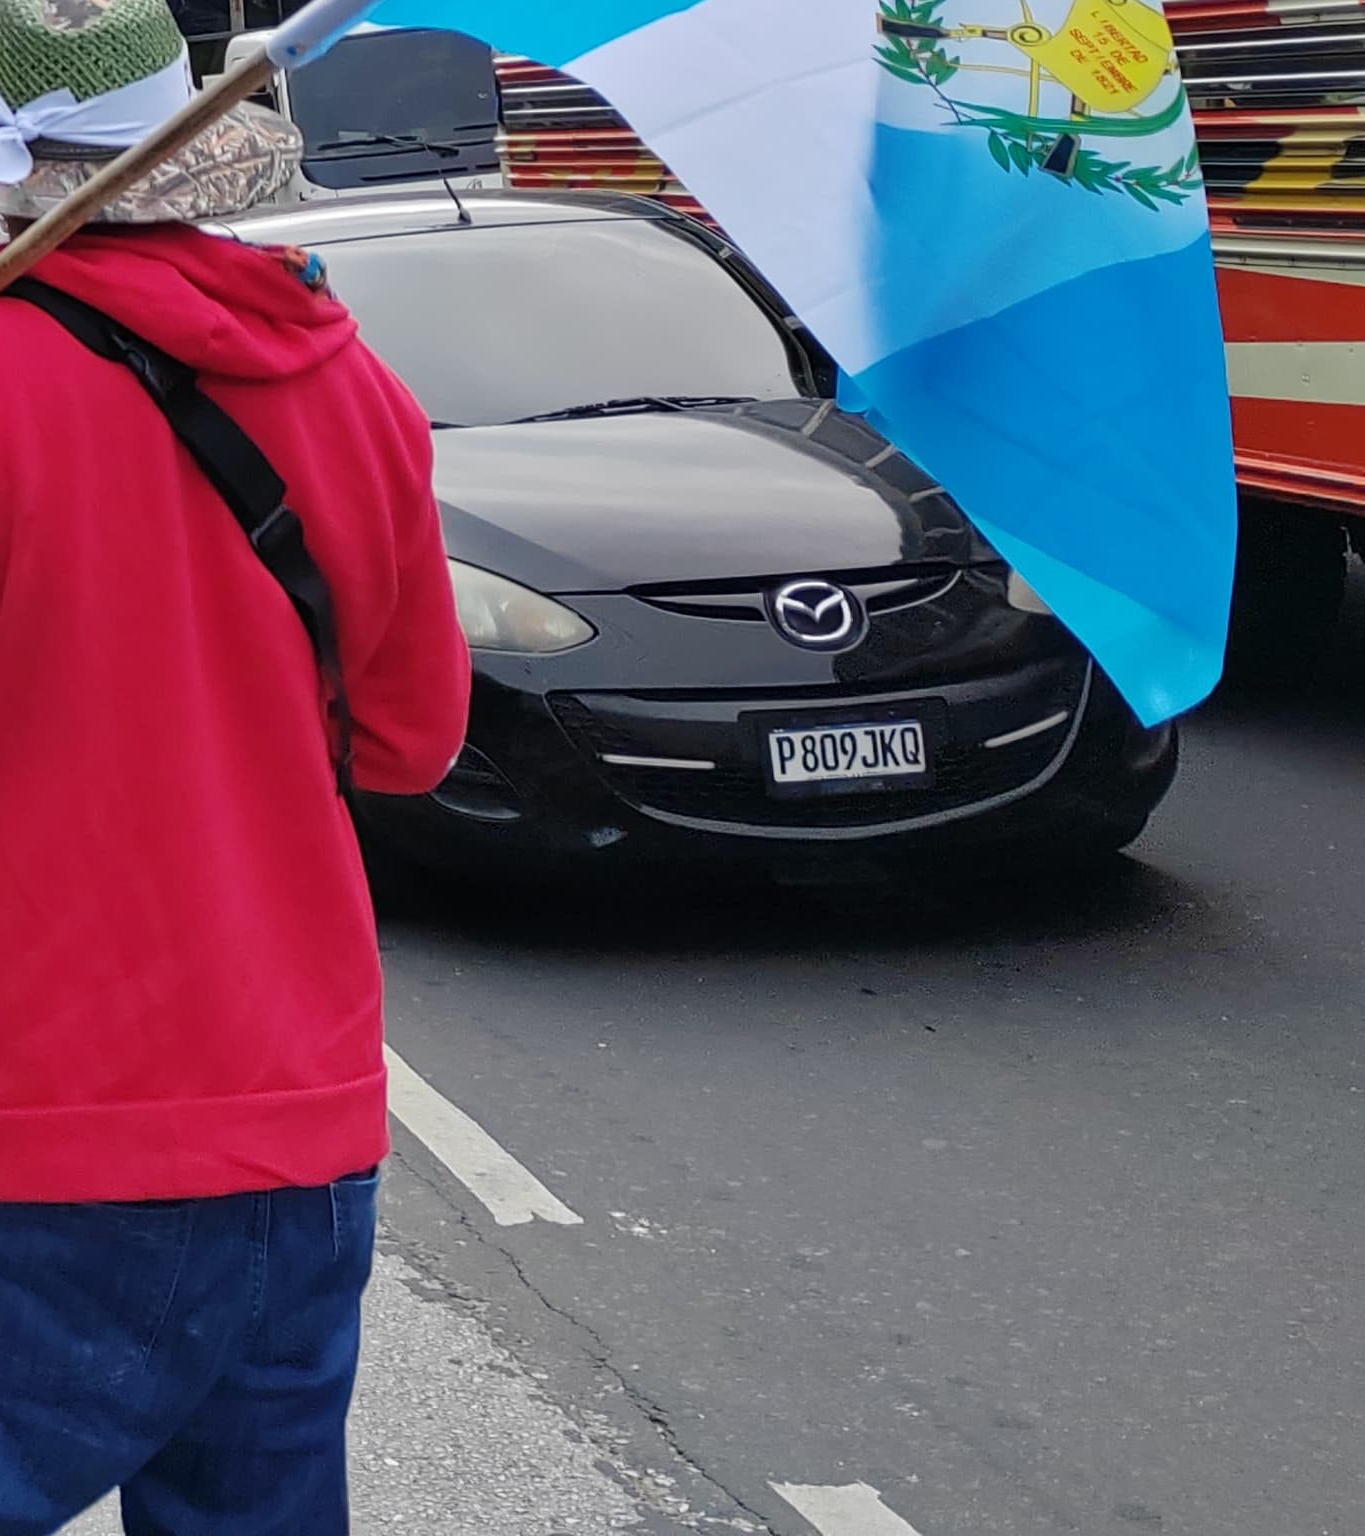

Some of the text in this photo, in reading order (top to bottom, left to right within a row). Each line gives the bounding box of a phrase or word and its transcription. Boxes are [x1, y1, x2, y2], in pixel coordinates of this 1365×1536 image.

[1090, 10, 1149, 64] LIBERTAD
[1070, 49, 1087, 64] DE
[1110, 50, 1131, 66] DE
